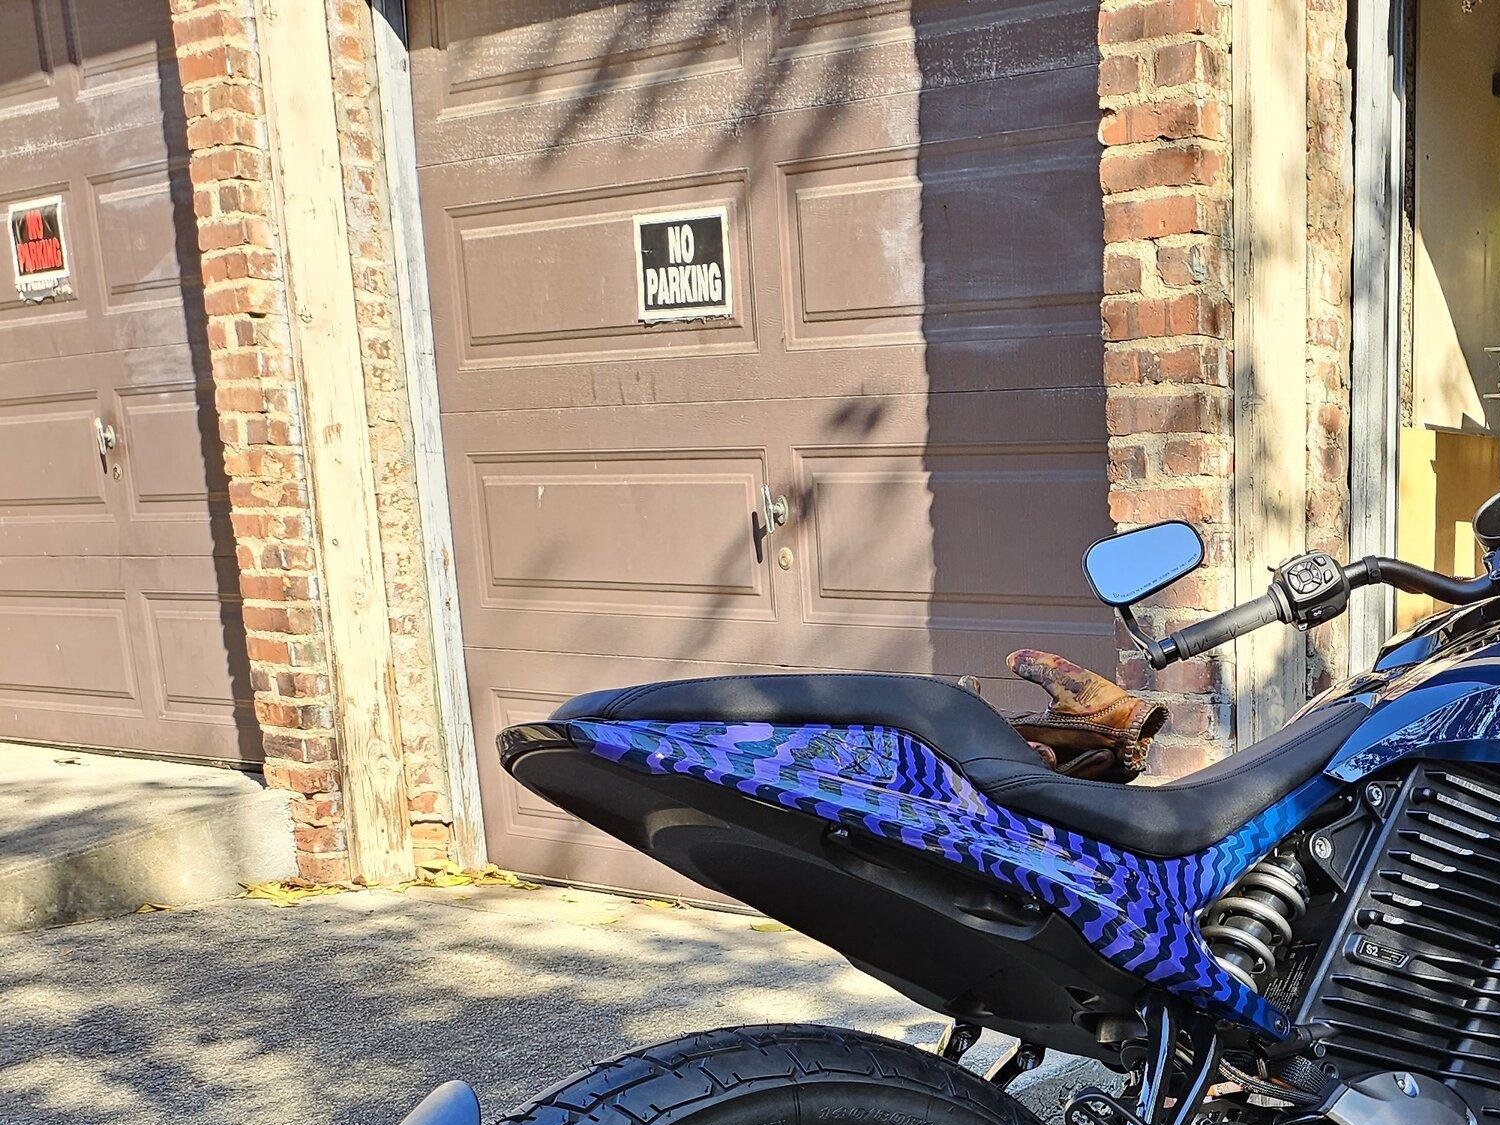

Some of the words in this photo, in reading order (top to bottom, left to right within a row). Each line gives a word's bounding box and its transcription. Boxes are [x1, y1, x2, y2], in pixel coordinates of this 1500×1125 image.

[26, 209, 43, 241] NO
[17, 237, 62, 273] PARKING
[667, 223, 695, 264] NO
[645, 262, 722, 306] PARKING
[1366, 944, 1379, 957] S2
